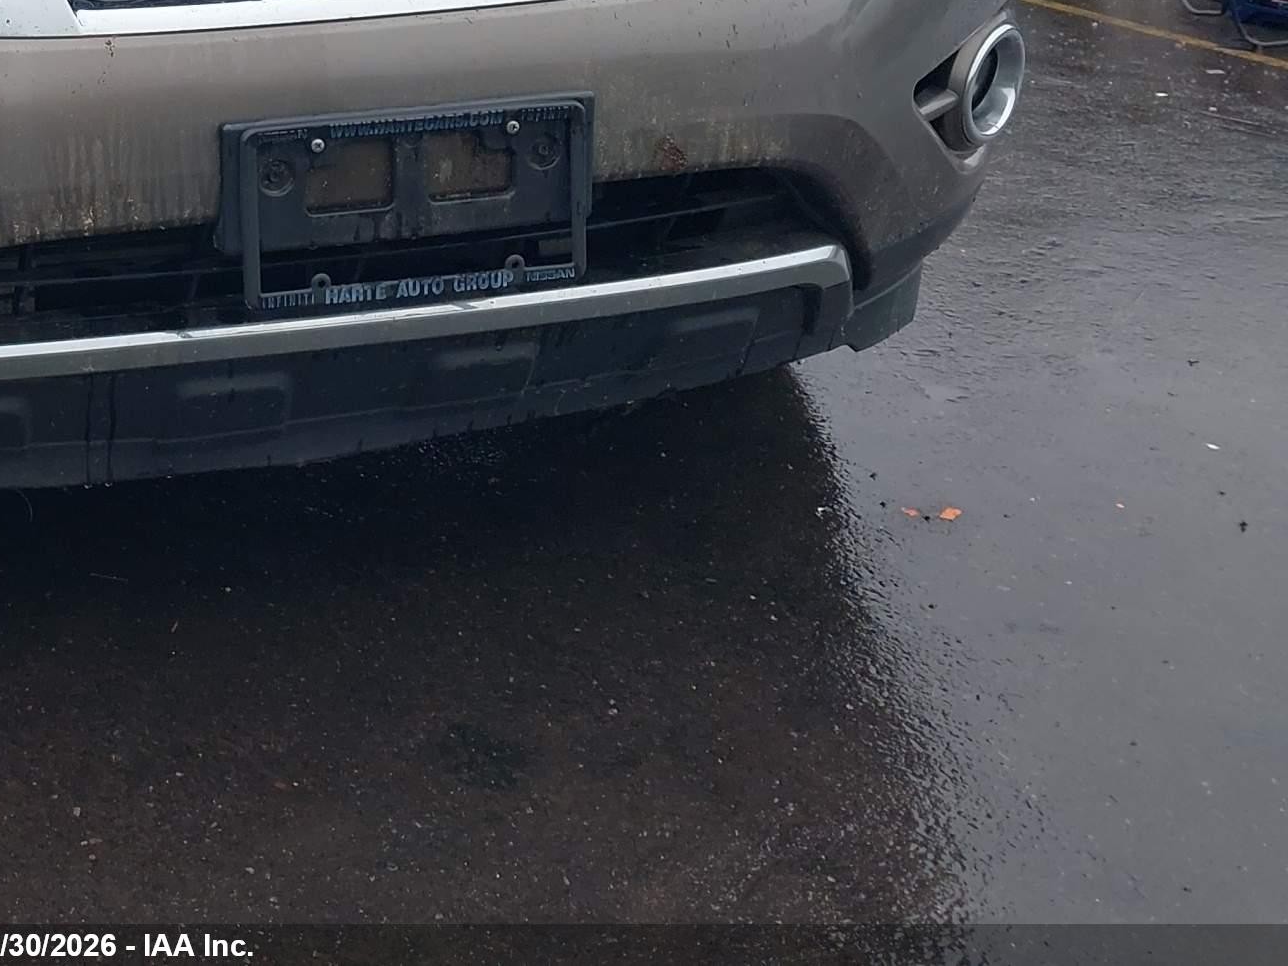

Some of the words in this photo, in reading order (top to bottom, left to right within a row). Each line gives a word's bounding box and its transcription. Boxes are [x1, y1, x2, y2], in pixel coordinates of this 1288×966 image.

[325, 282, 387, 304] HARTE
[396, 276, 445, 298] AUTO
[453, 269, 514, 293] GROUP
[526, 267, 576, 282] NISSAN
